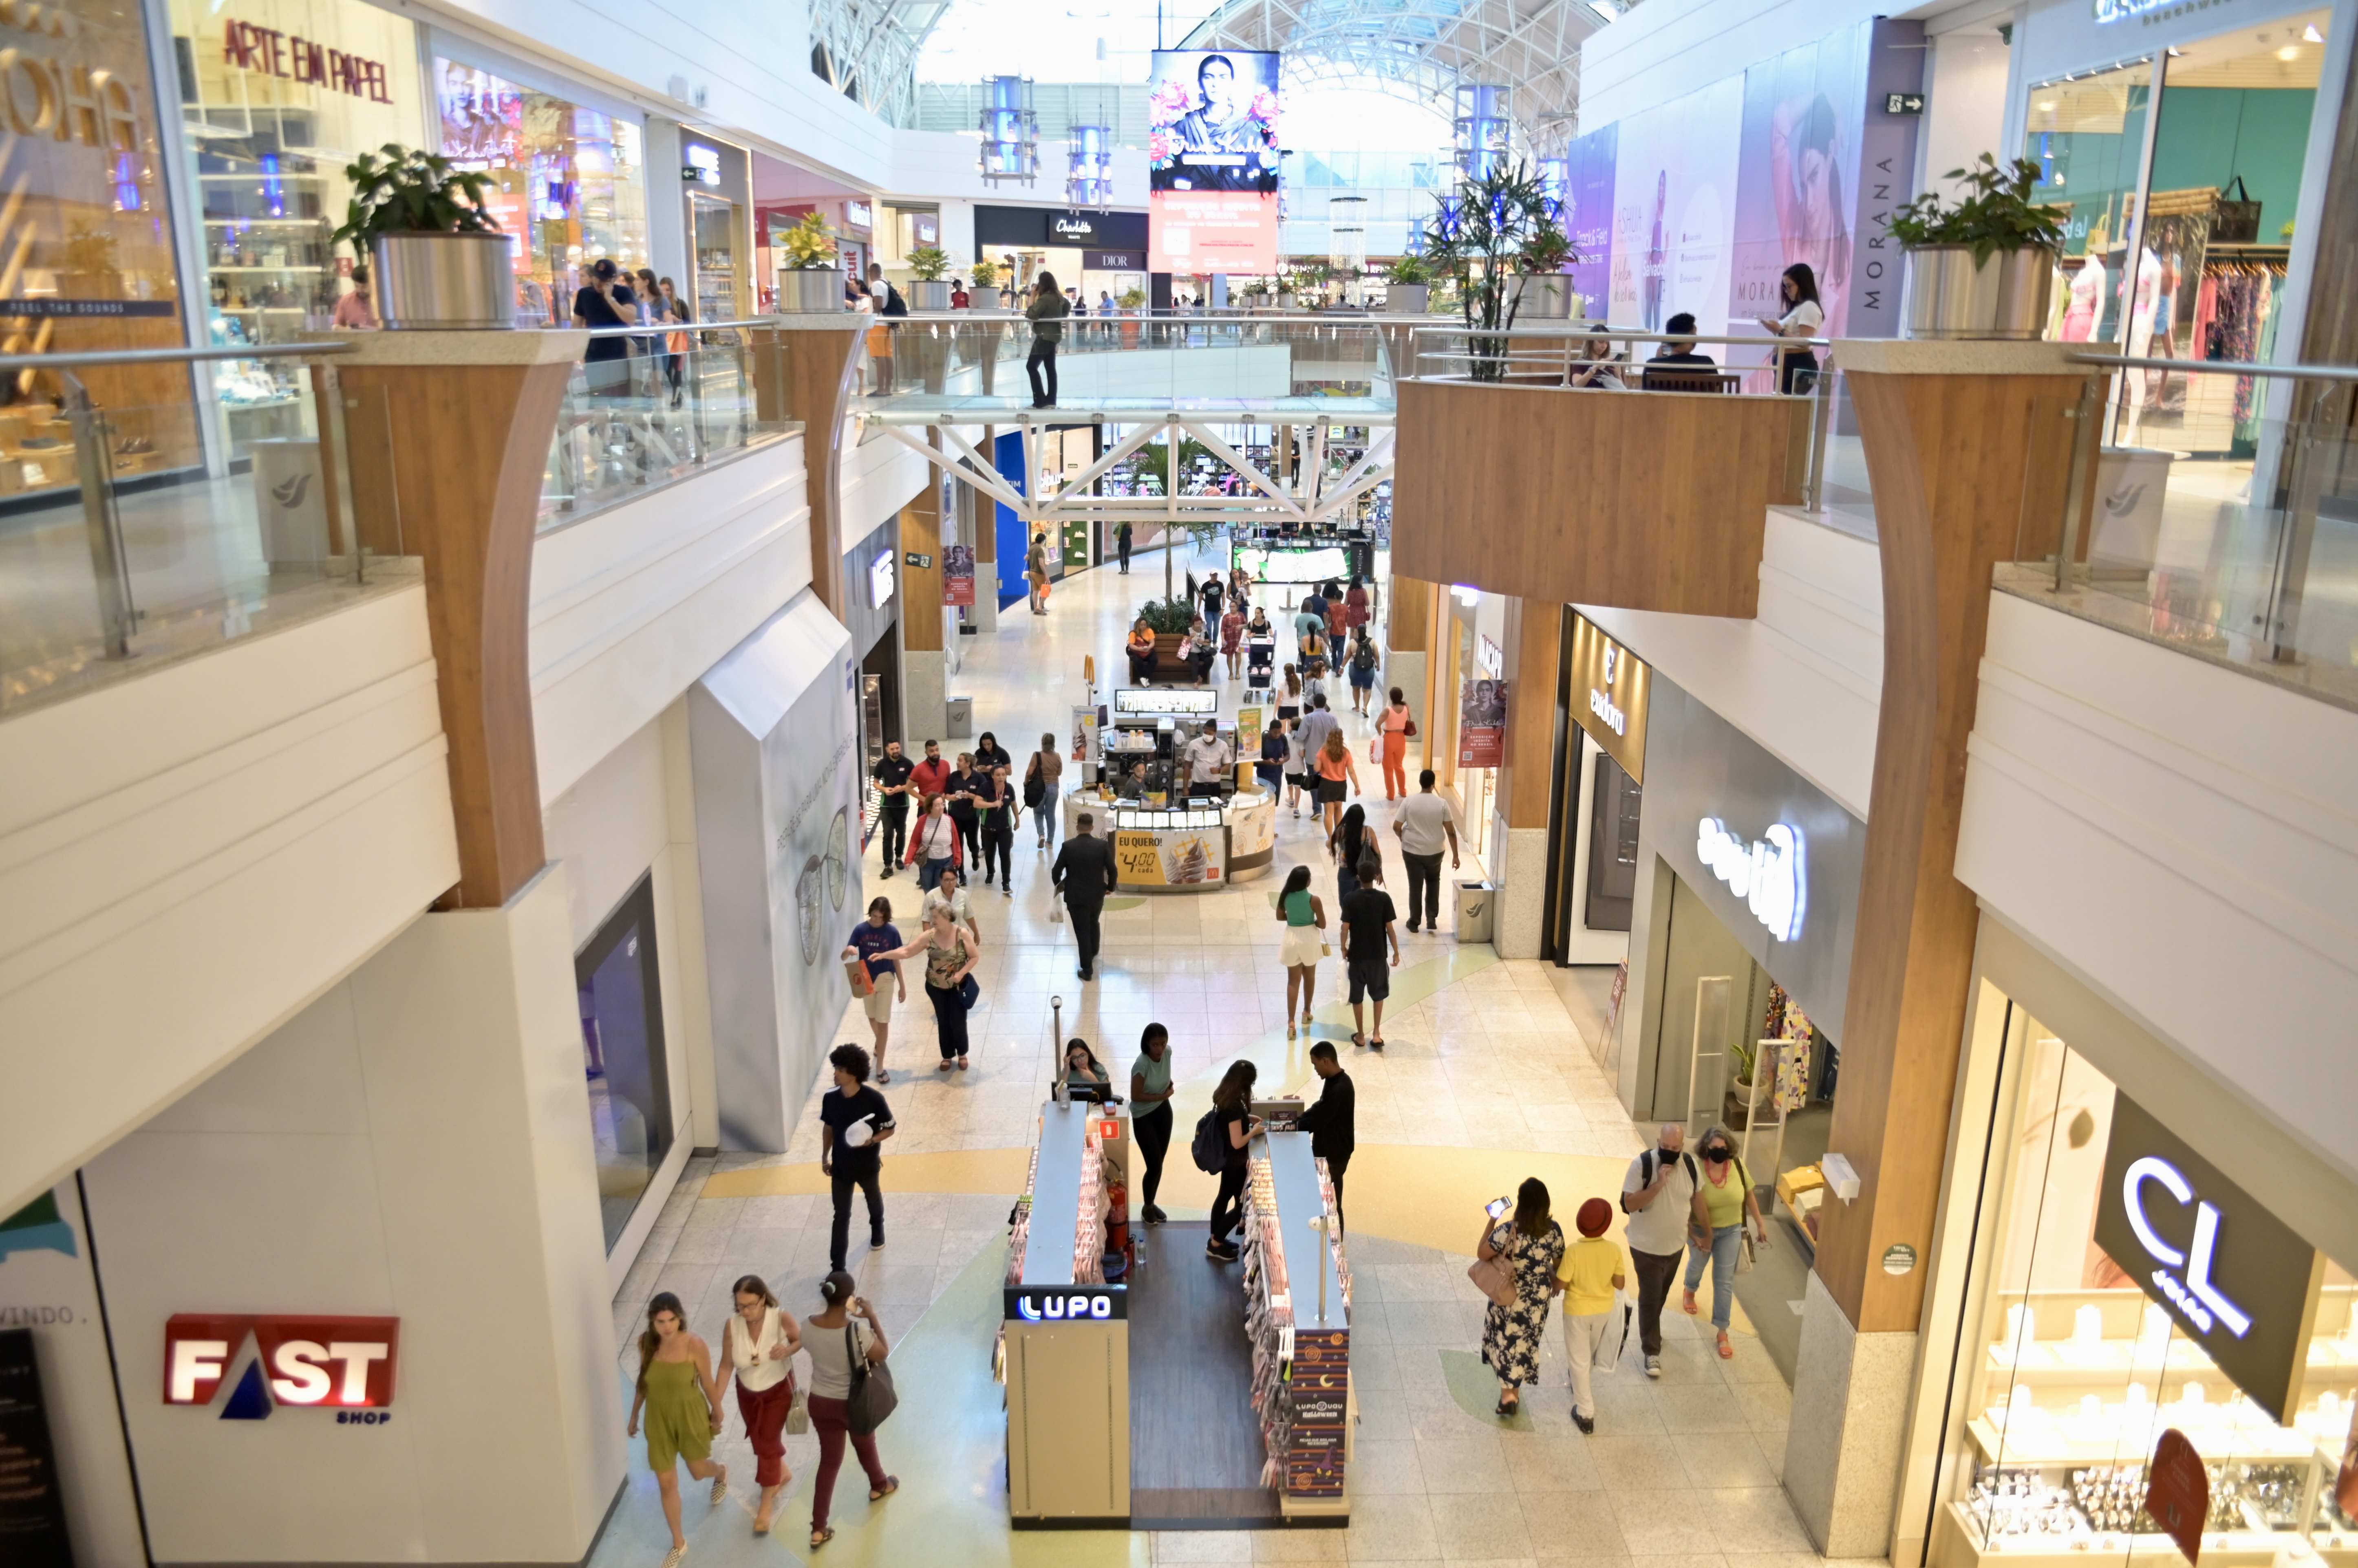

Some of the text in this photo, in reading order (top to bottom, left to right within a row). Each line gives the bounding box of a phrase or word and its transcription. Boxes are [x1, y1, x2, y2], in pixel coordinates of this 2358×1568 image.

[225, 18, 394, 104] ARTE EM PAPEL
[1056, 219, 1092, 233] Charlotte
[1864, 158, 1893, 309] MORANA
[1103, 255, 1127, 266] DIOR
[1119, 837, 1162, 848] EU QUERO!
[1021, 1296, 1110, 1320] LUPO
[171, 1328, 389, 1420] FAST
[336, 1411, 391, 1425] SHOP
